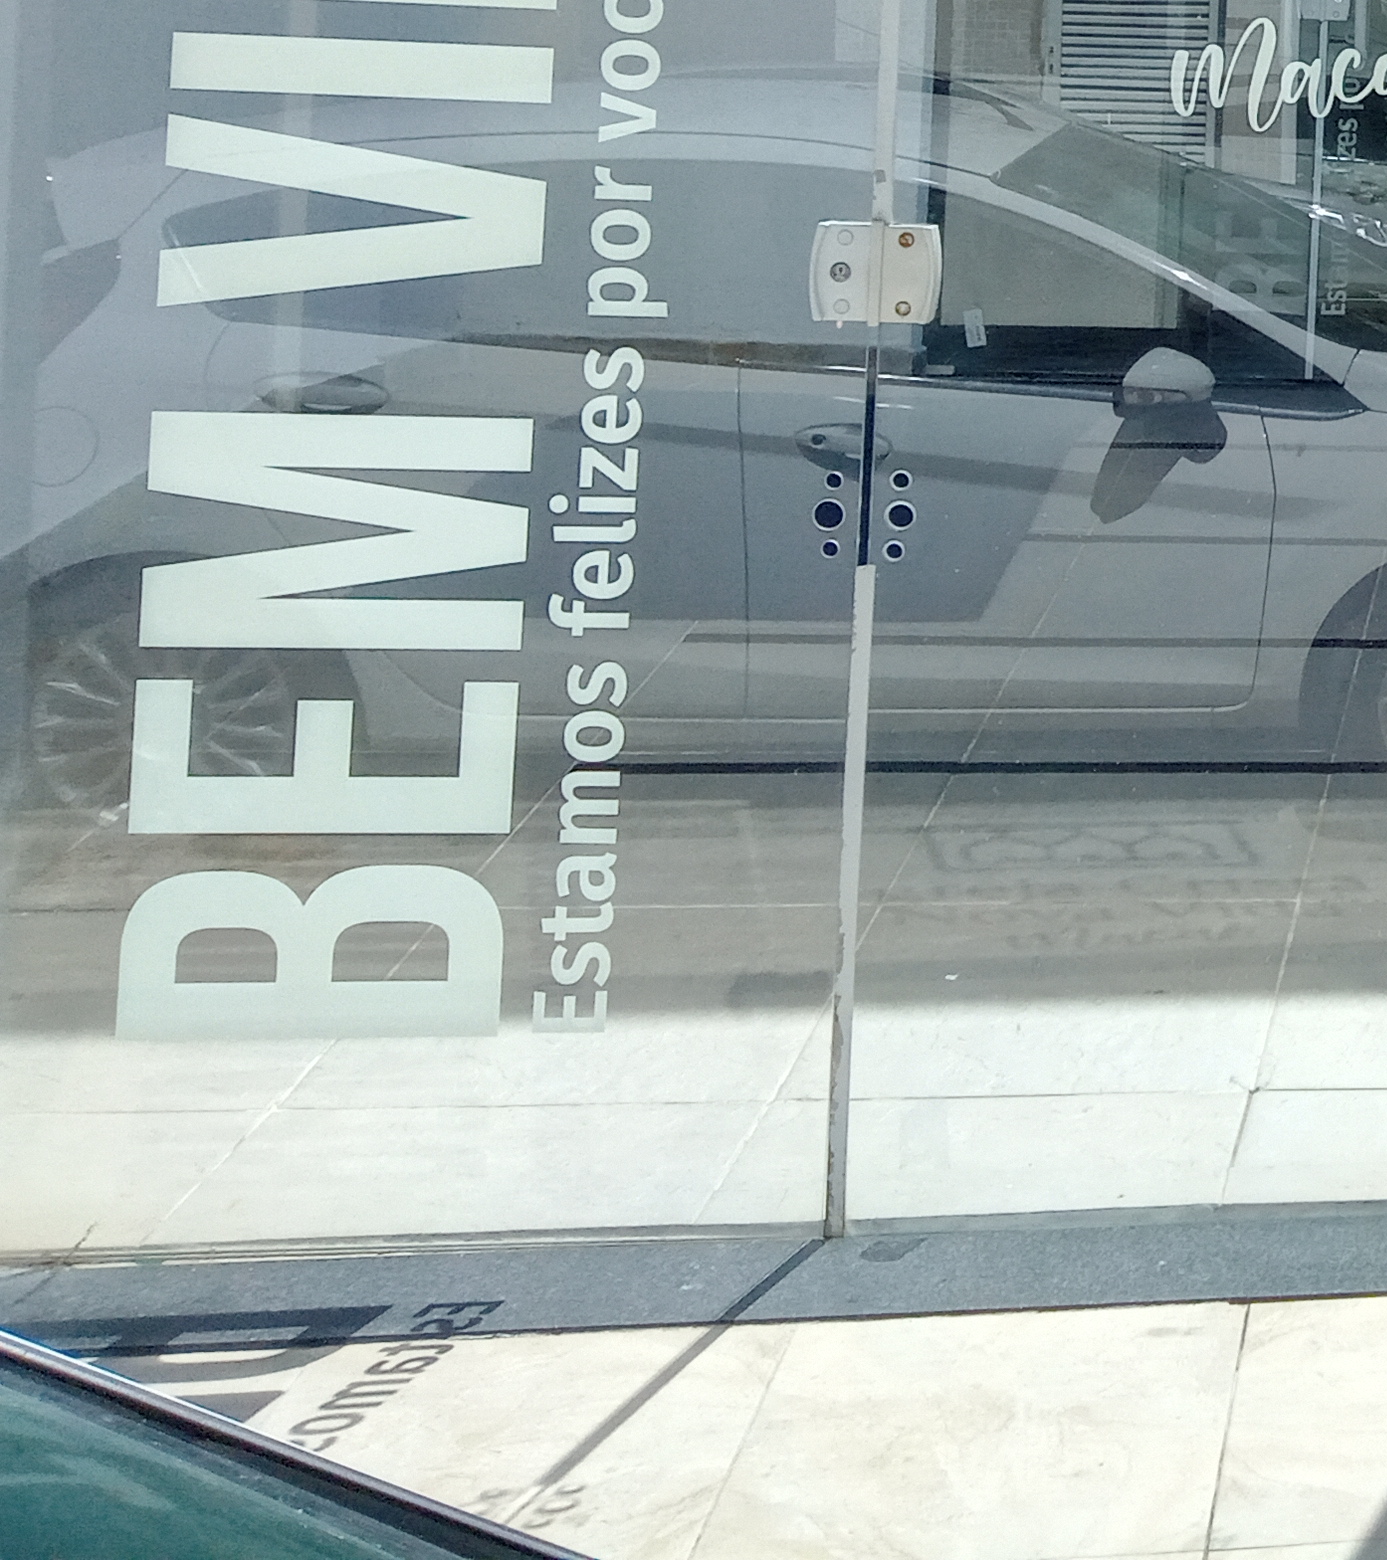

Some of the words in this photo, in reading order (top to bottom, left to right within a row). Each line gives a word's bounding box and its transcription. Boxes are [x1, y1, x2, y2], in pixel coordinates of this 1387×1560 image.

[588, 166, 668, 317] por
[549, 347, 645, 636] felizes
[114, 411, 535, 1037] BEM
[532, 663, 626, 1034] Estamos
